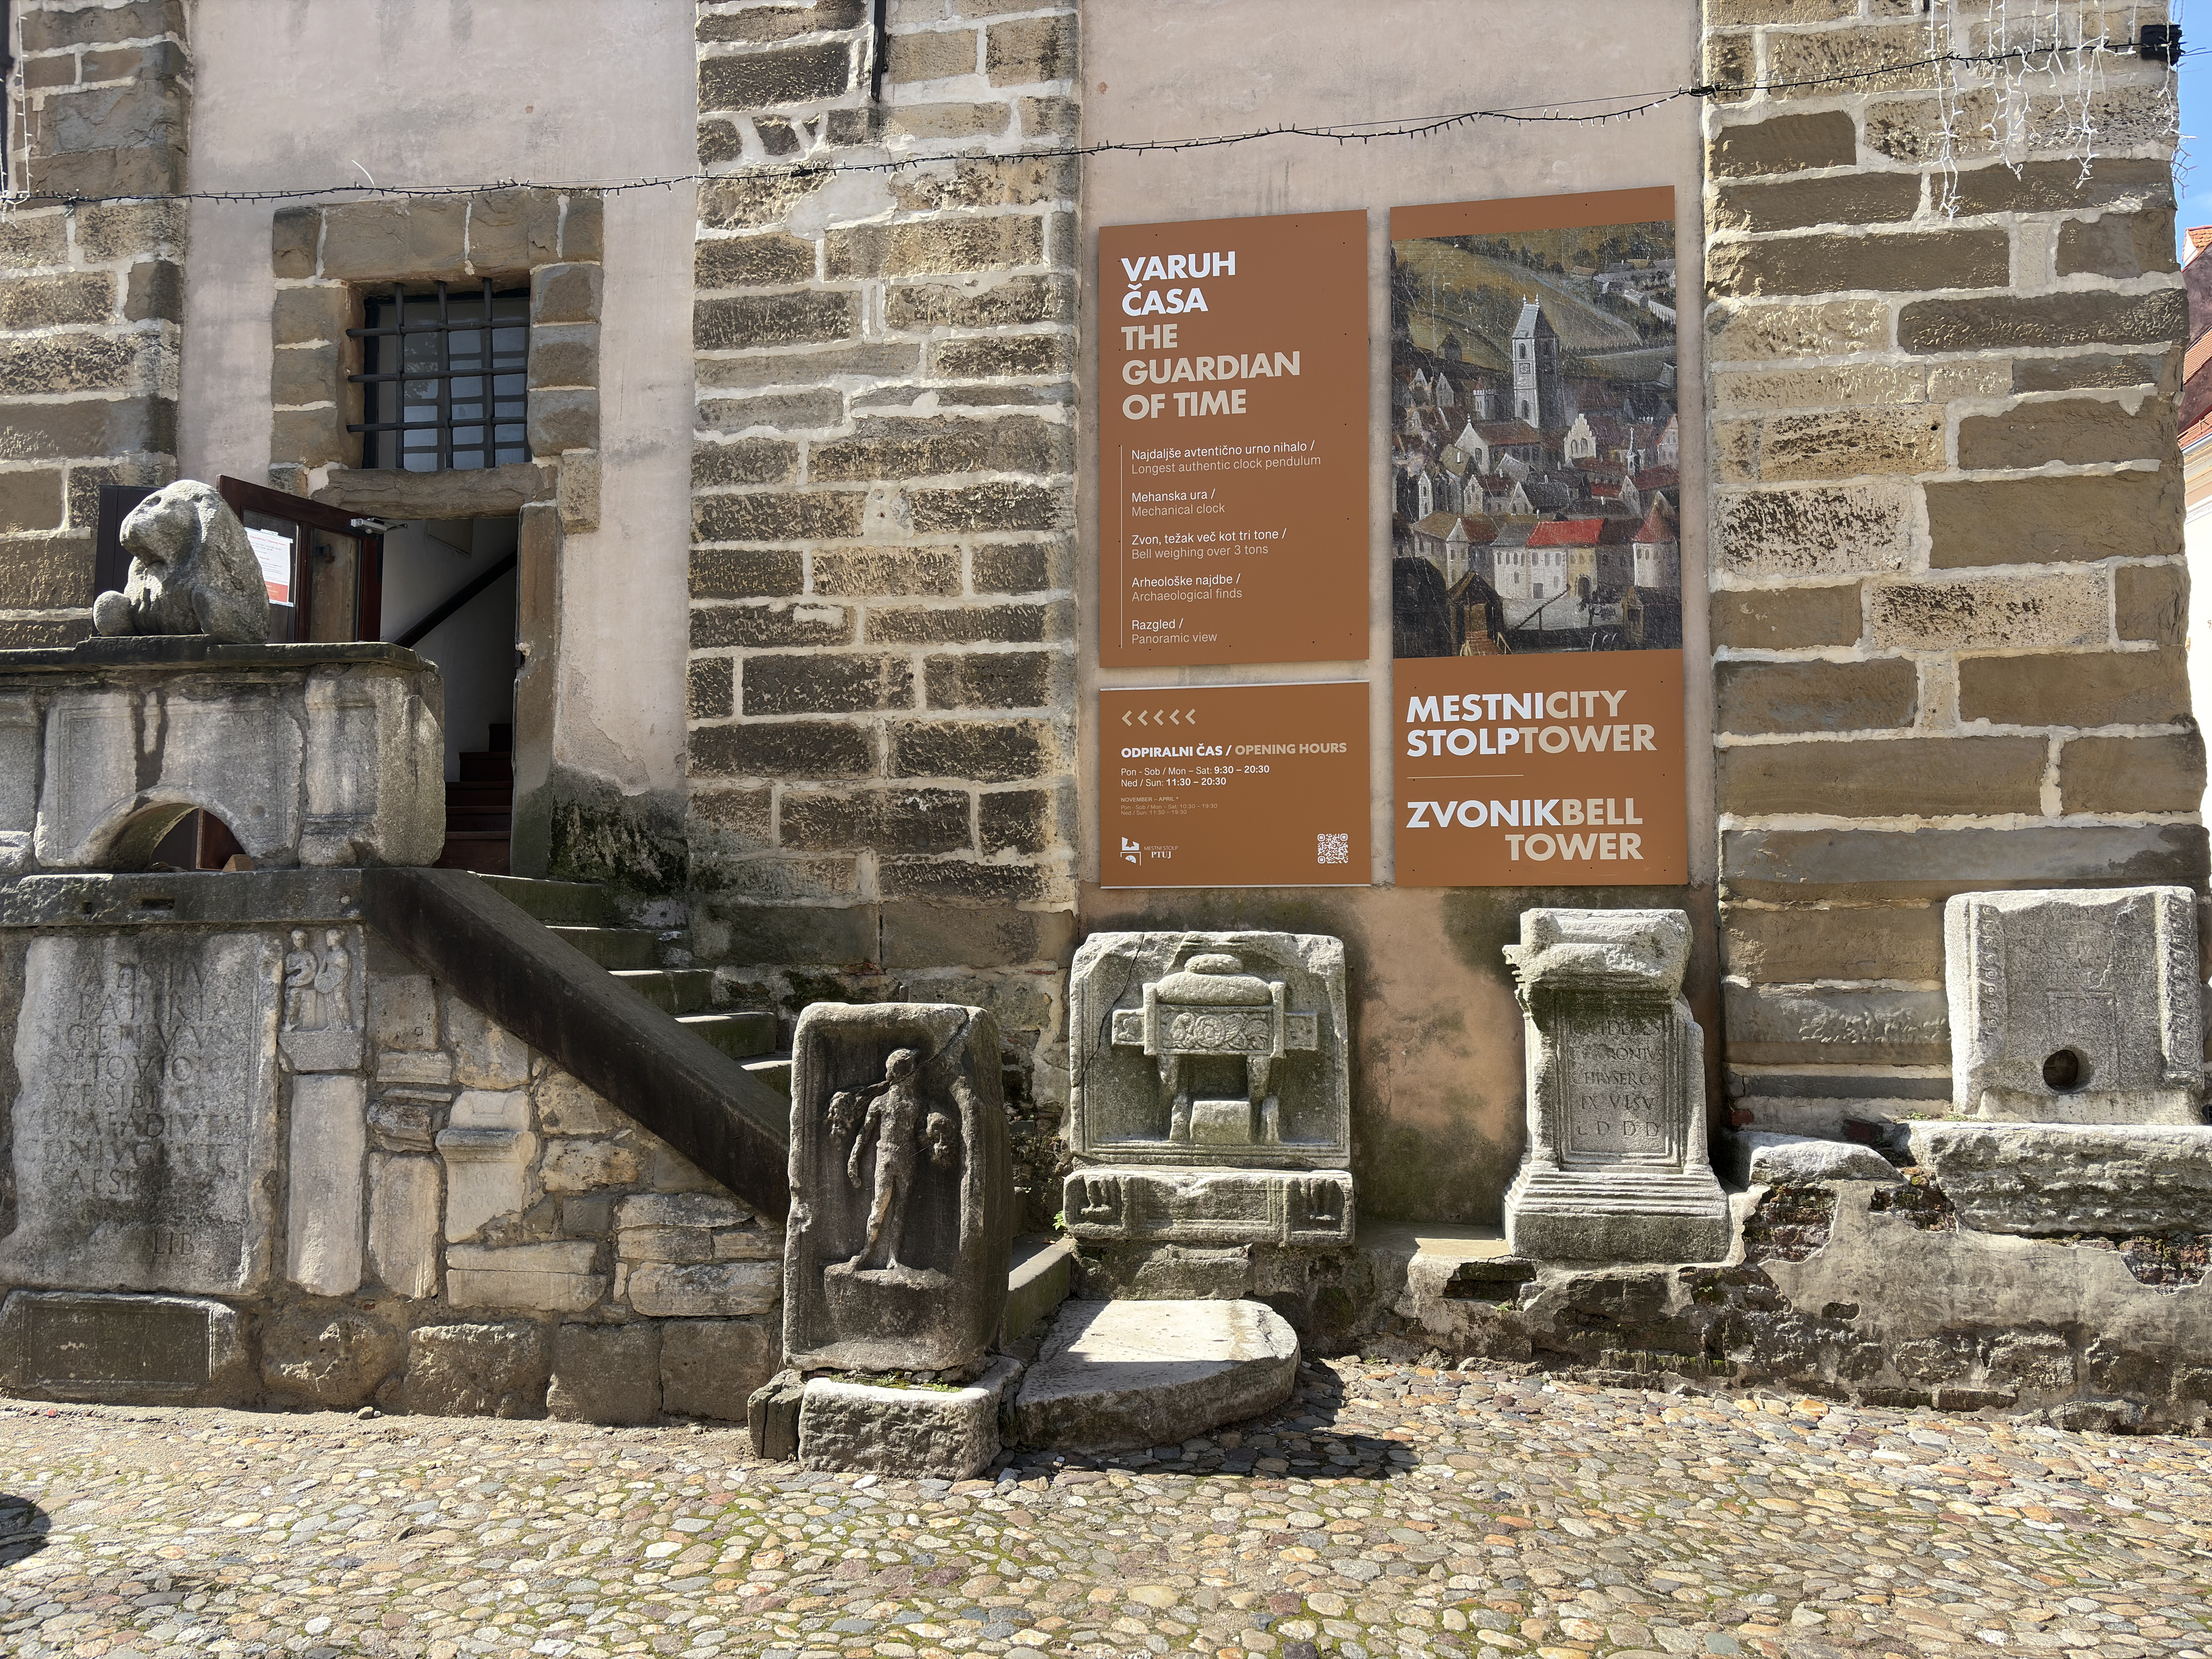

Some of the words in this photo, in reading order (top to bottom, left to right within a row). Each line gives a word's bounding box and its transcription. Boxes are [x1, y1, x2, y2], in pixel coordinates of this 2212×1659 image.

[1121, 251, 1235, 281] VARUH
[1122, 283, 1208, 316] ČASA
[1121, 324, 1177, 350] THE
[1123, 351, 1300, 385] GUARDIAN
[1123, 394, 1165, 420] OF
[1173, 389, 1246, 416] TIME
[1133, 448, 1181, 461] Najdaljše
[1185, 445, 1241, 457] avtentično
[1246, 446, 1270, 454] urno
[1274, 441, 1306, 452] nihalo
[1311, 440, 1314, 451] /
[1133, 463, 1175, 476] Longest
[1179, 460, 1230, 472] authentic
[1234, 458, 1262, 469] clock
[1266, 456, 1320, 469] pendulum
[1133, 491, 1187, 502] Mehanska
[1211, 488, 1215, 499] /
[1133, 504, 1192, 517] Mechanical
[1197, 503, 1224, 513] clock
[1132, 535, 1161, 545] Zvon,
[1165, 533, 1193, 544] težak
[1197, 531, 1215, 542] več
[1220, 531, 1235, 541] kot
[1239, 530, 1250, 540] tri
[1254, 531, 1278, 539] tone
[1282, 528, 1286, 539] /
[1133, 549, 1151, 559] Bell
[1155, 547, 1203, 560] weighing
[1235, 545, 1240, 555] 3
[1245, 545, 1268, 554] tons
[1132, 576, 1192, 587] Arheološke
[1196, 575, 1232, 587] najdbe
[1236, 573, 1240, 583] /
[1132, 589, 1212, 602] Archaeological
[1215, 588, 1241, 598] finds
[1133, 619, 1175, 632] Razgled
[1179, 618, 1183, 628] /
[1133, 633, 1189, 644] Panoramic
[1193, 633, 1217, 641] view
[1121, 747, 1193, 758] ODPIRALNI
[1197, 743, 1222, 756] ČAS
[1225, 745, 1232, 756] /
[1235, 744, 1295, 755] OPENING
[1300, 743, 1347, 753] HOURS
[1505, 833, 1644, 861] TOWER
[1597, 1121, 1610, 1135] D
[1623, 1121, 1636, 1136] D
[1647, 1121, 1658, 1137] D
